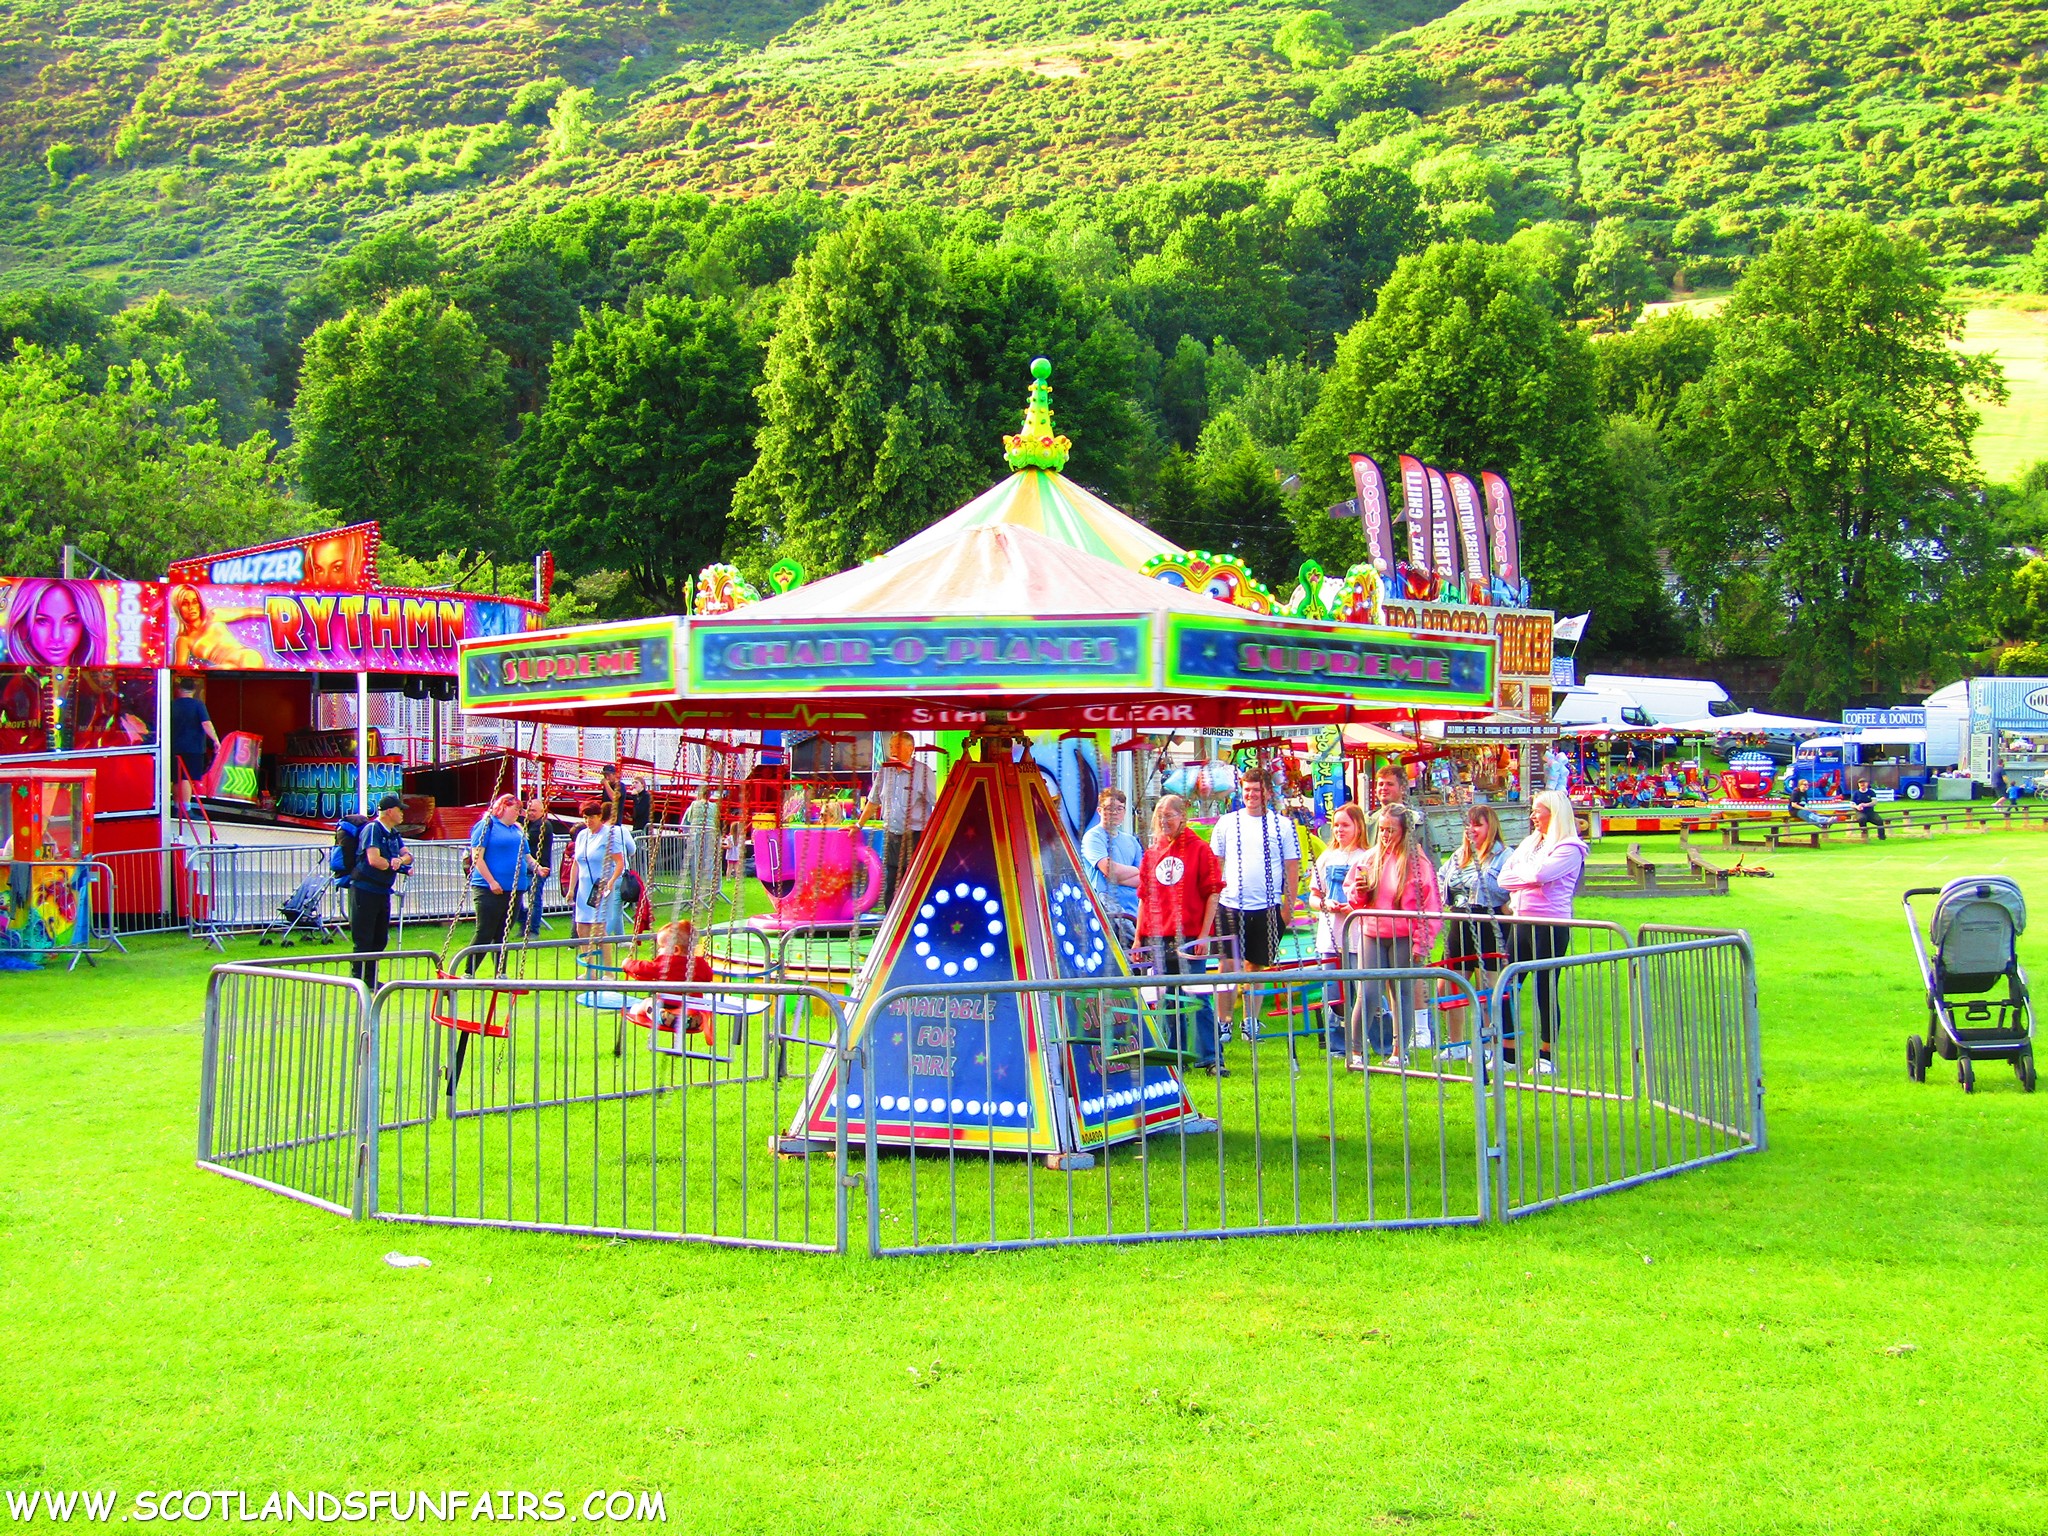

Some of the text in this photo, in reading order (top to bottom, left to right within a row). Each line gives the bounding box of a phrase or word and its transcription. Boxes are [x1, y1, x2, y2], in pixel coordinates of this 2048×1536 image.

[211, 549, 303, 584] WALTZER
[116, 582, 145, 663] POWER
[264, 595, 465, 652] RYTHMN
[502, 646, 641, 685] SUPREME
[724, 636, 1119, 671] CHAIR-O-PLANES
[1239, 643, 1450, 684] SUPREME
[911, 704, 1196, 723] STAD CLEAR
[1845, 713, 1924, 724] COFFEE & DONUTS
[1202, 727, 1234, 737] BURGERS
[234, 736, 251, 764] 5
[1313, 726, 1337, 790] FACORY
[280, 762, 403, 789] YTHMN MASTE
[322, 793, 336, 819] U
[1165, 871, 1173, 882] 3
[889, 996, 997, 1020] AVAILABLE
[917, 1025, 957, 1048] FOR
[911, 1054, 957, 1077] HIRE
